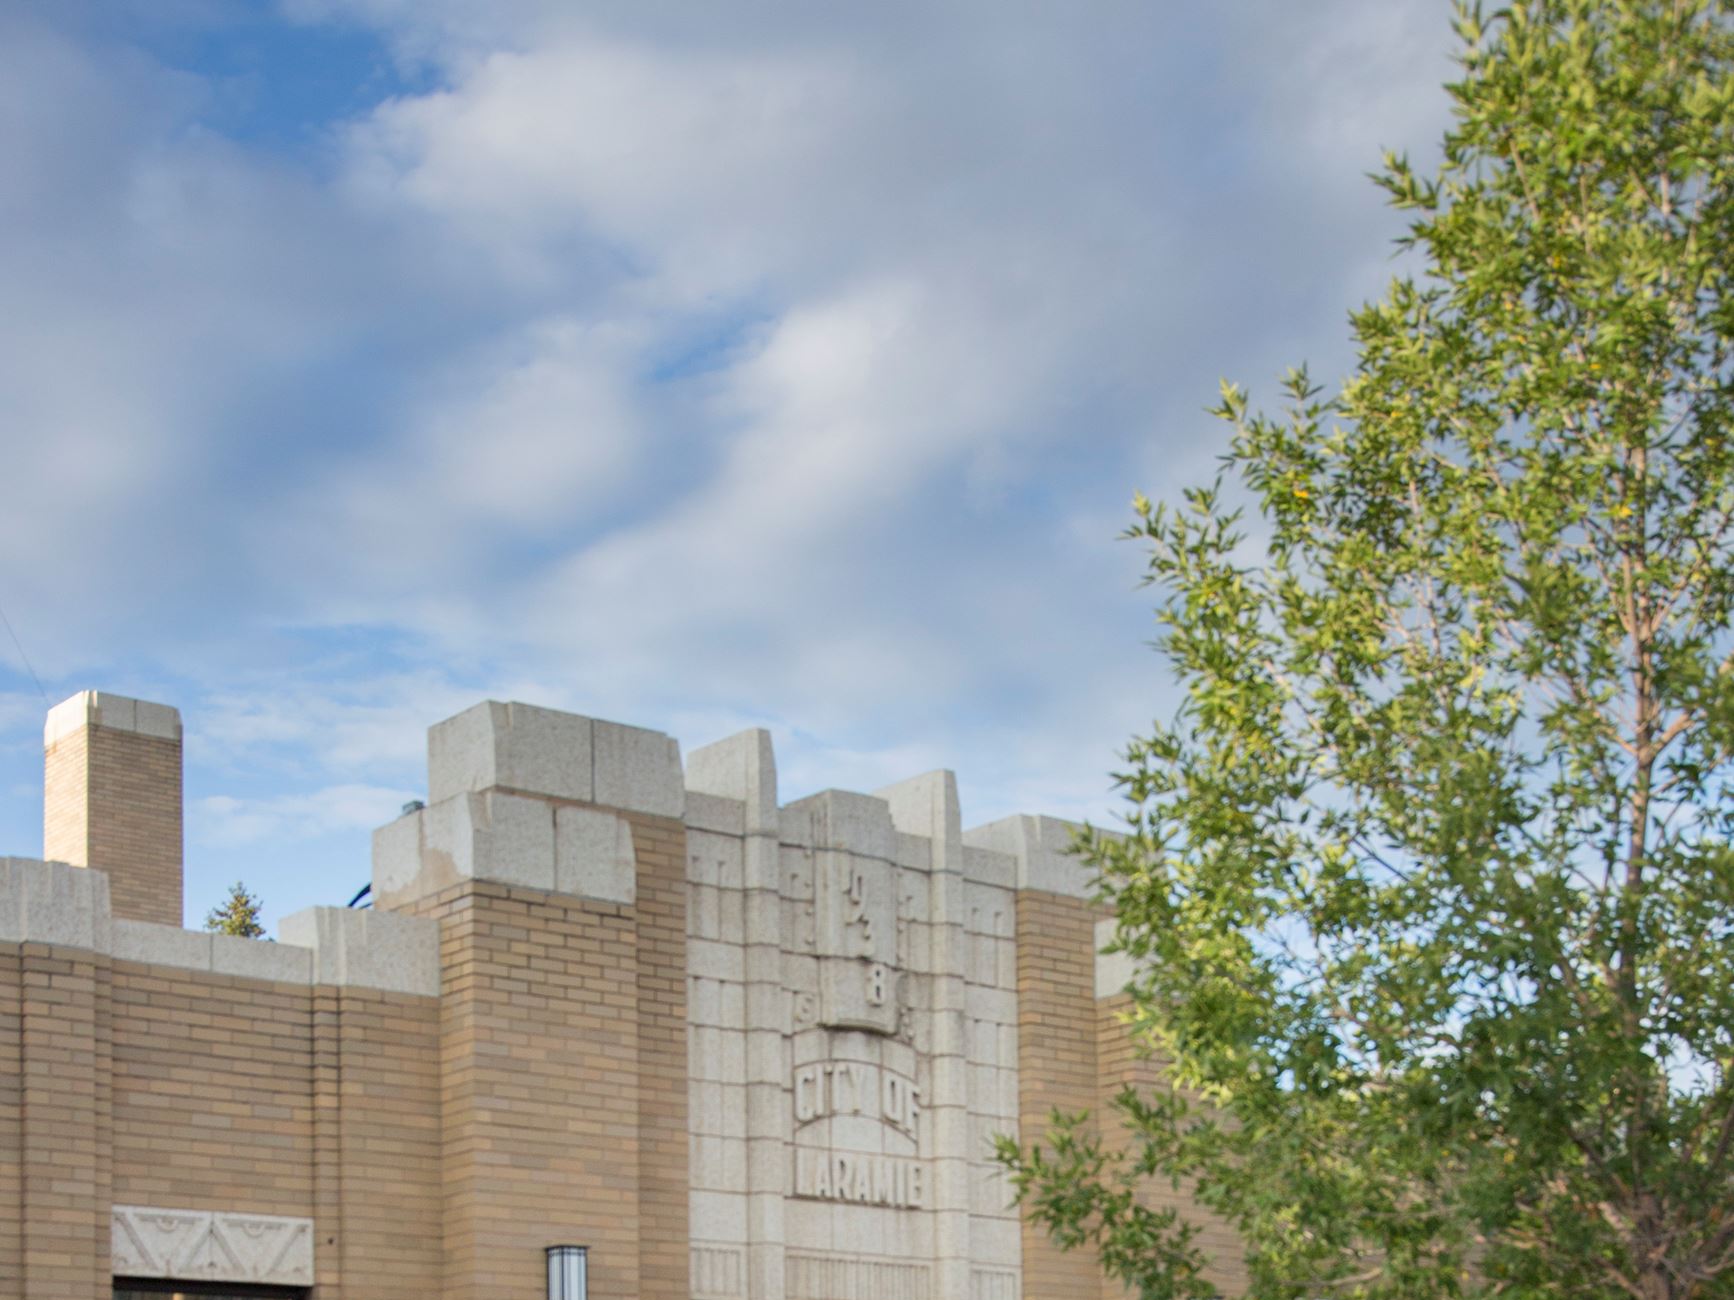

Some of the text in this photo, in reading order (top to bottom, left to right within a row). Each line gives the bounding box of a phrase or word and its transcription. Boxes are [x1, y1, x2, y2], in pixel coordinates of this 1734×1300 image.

[795, 1063, 920, 1134] CITY OF
[796, 1149, 923, 1207] LARAMIE
